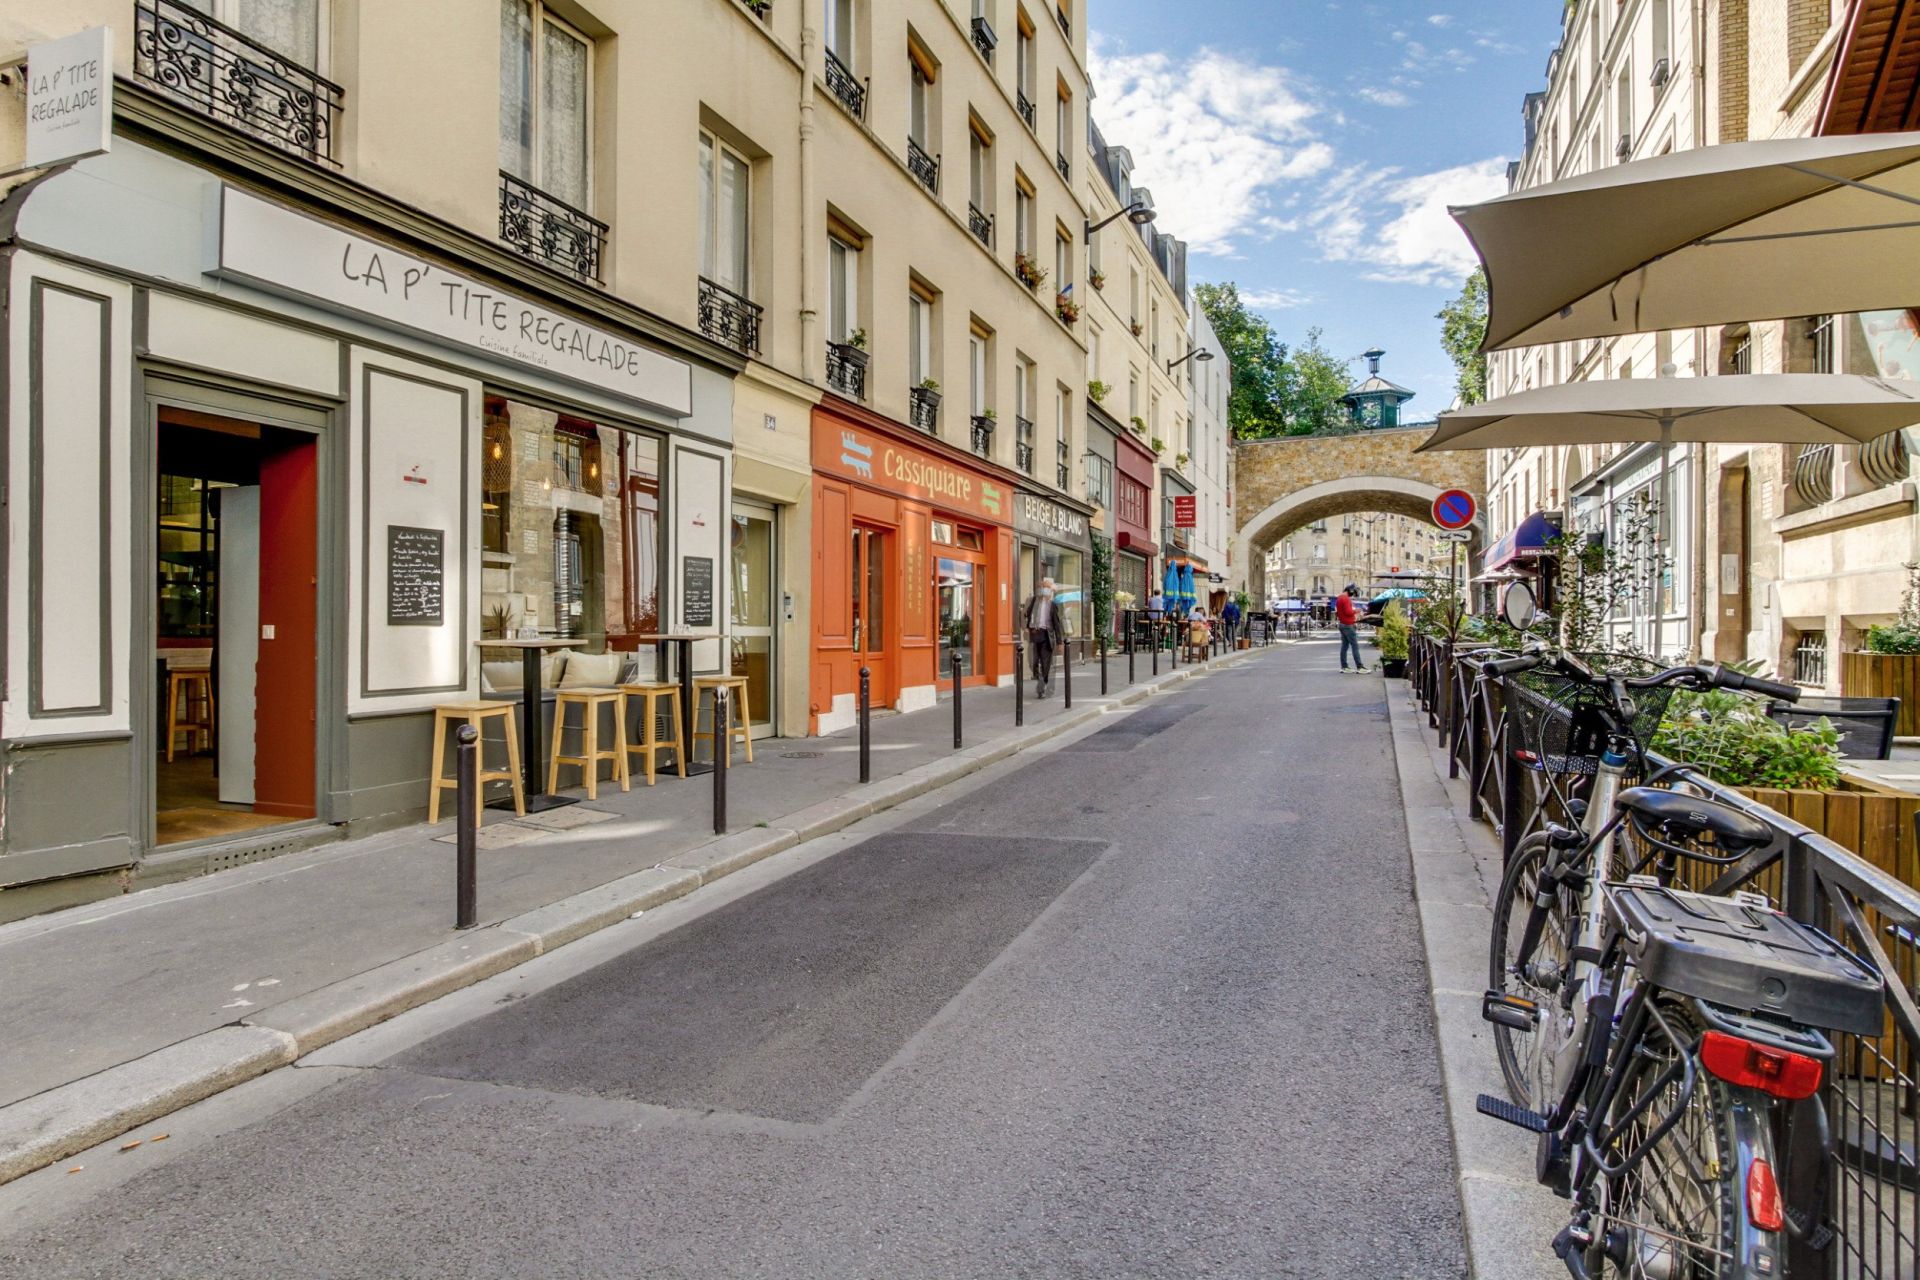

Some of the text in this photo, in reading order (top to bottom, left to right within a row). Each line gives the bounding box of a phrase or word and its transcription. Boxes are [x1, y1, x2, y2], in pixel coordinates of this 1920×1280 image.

[33, 75, 48, 95] LA
[32, 88, 97, 123] REGALADE
[342, 243, 387, 294] LA
[519, 310, 639, 377] REGALADE
[480, 335, 510, 353] Cuisine
[884, 448, 971, 501] Cassiquiare
[1025, 496, 1050, 526] BEIGE
[1051, 507, 1058, 528] &
[1058, 509, 1082, 536] BLANC
